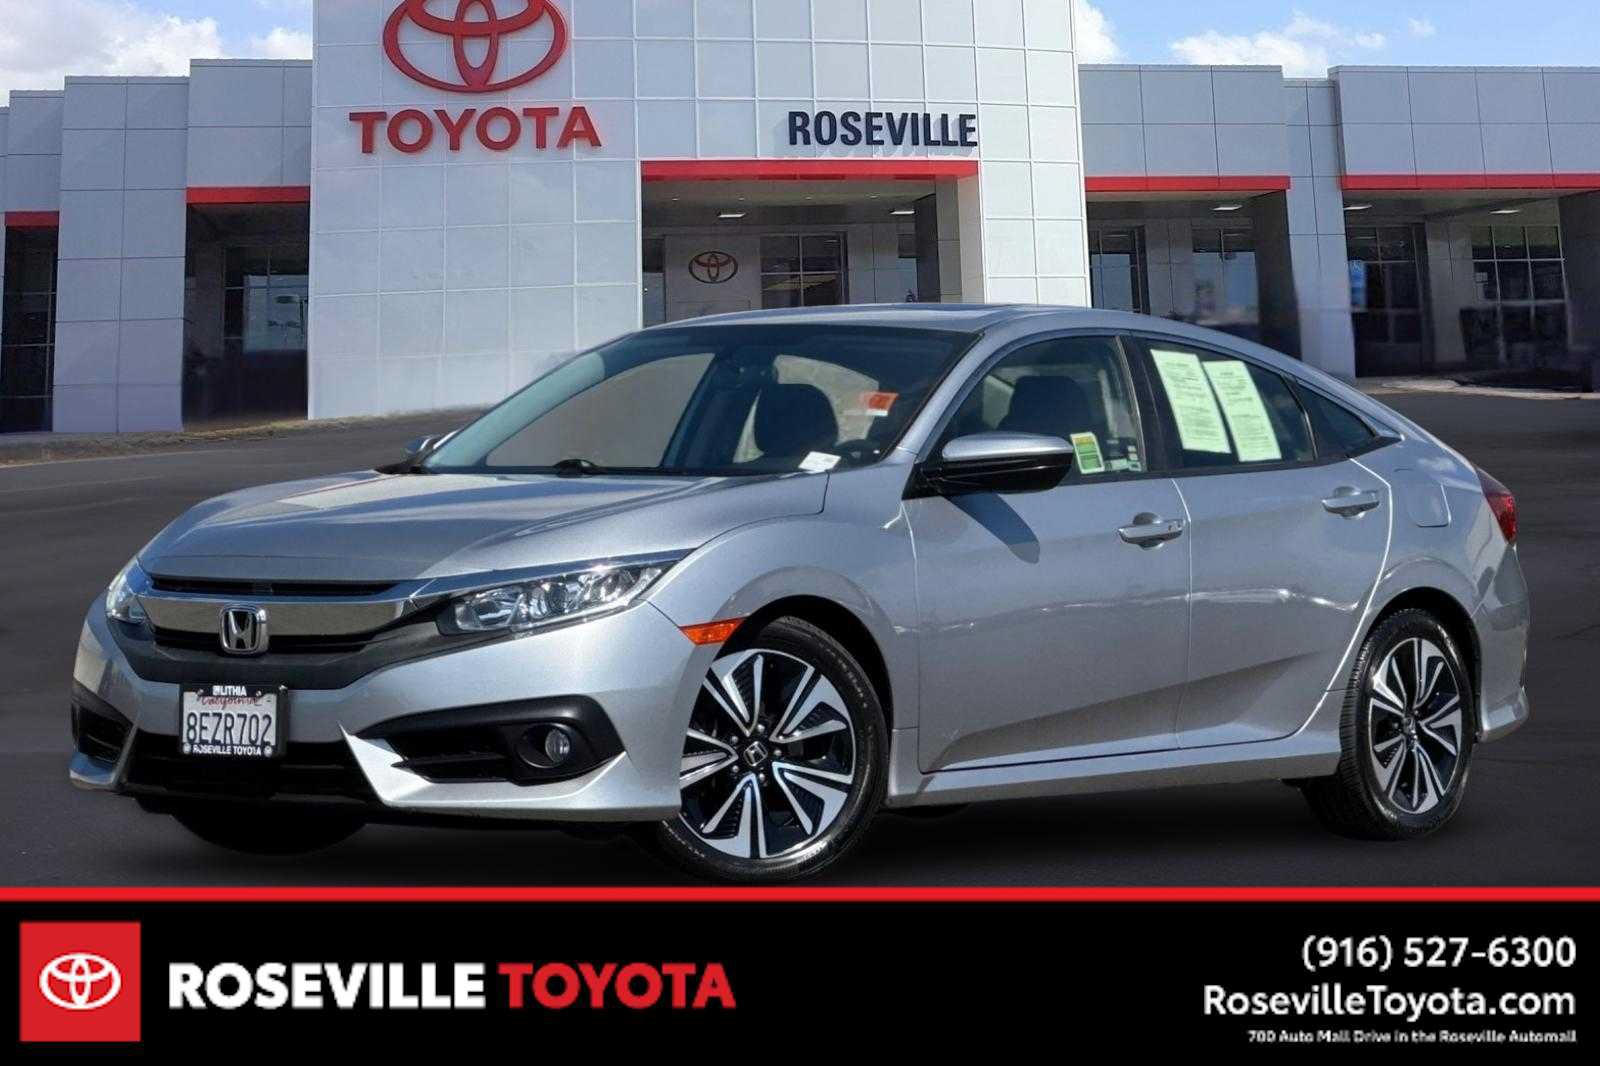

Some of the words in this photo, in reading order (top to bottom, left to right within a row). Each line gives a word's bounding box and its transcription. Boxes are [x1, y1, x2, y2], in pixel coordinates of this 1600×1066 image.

[349, 106, 602, 153] TOYOTA
[788, 111, 978, 147] ROSEVILLE
[220, 685, 248, 697] LITHIA
[186, 712, 272, 745] 8EZR702
[192, 744, 232, 755] ROSEVILLE
[233, 745, 262, 756] TOYOTA
